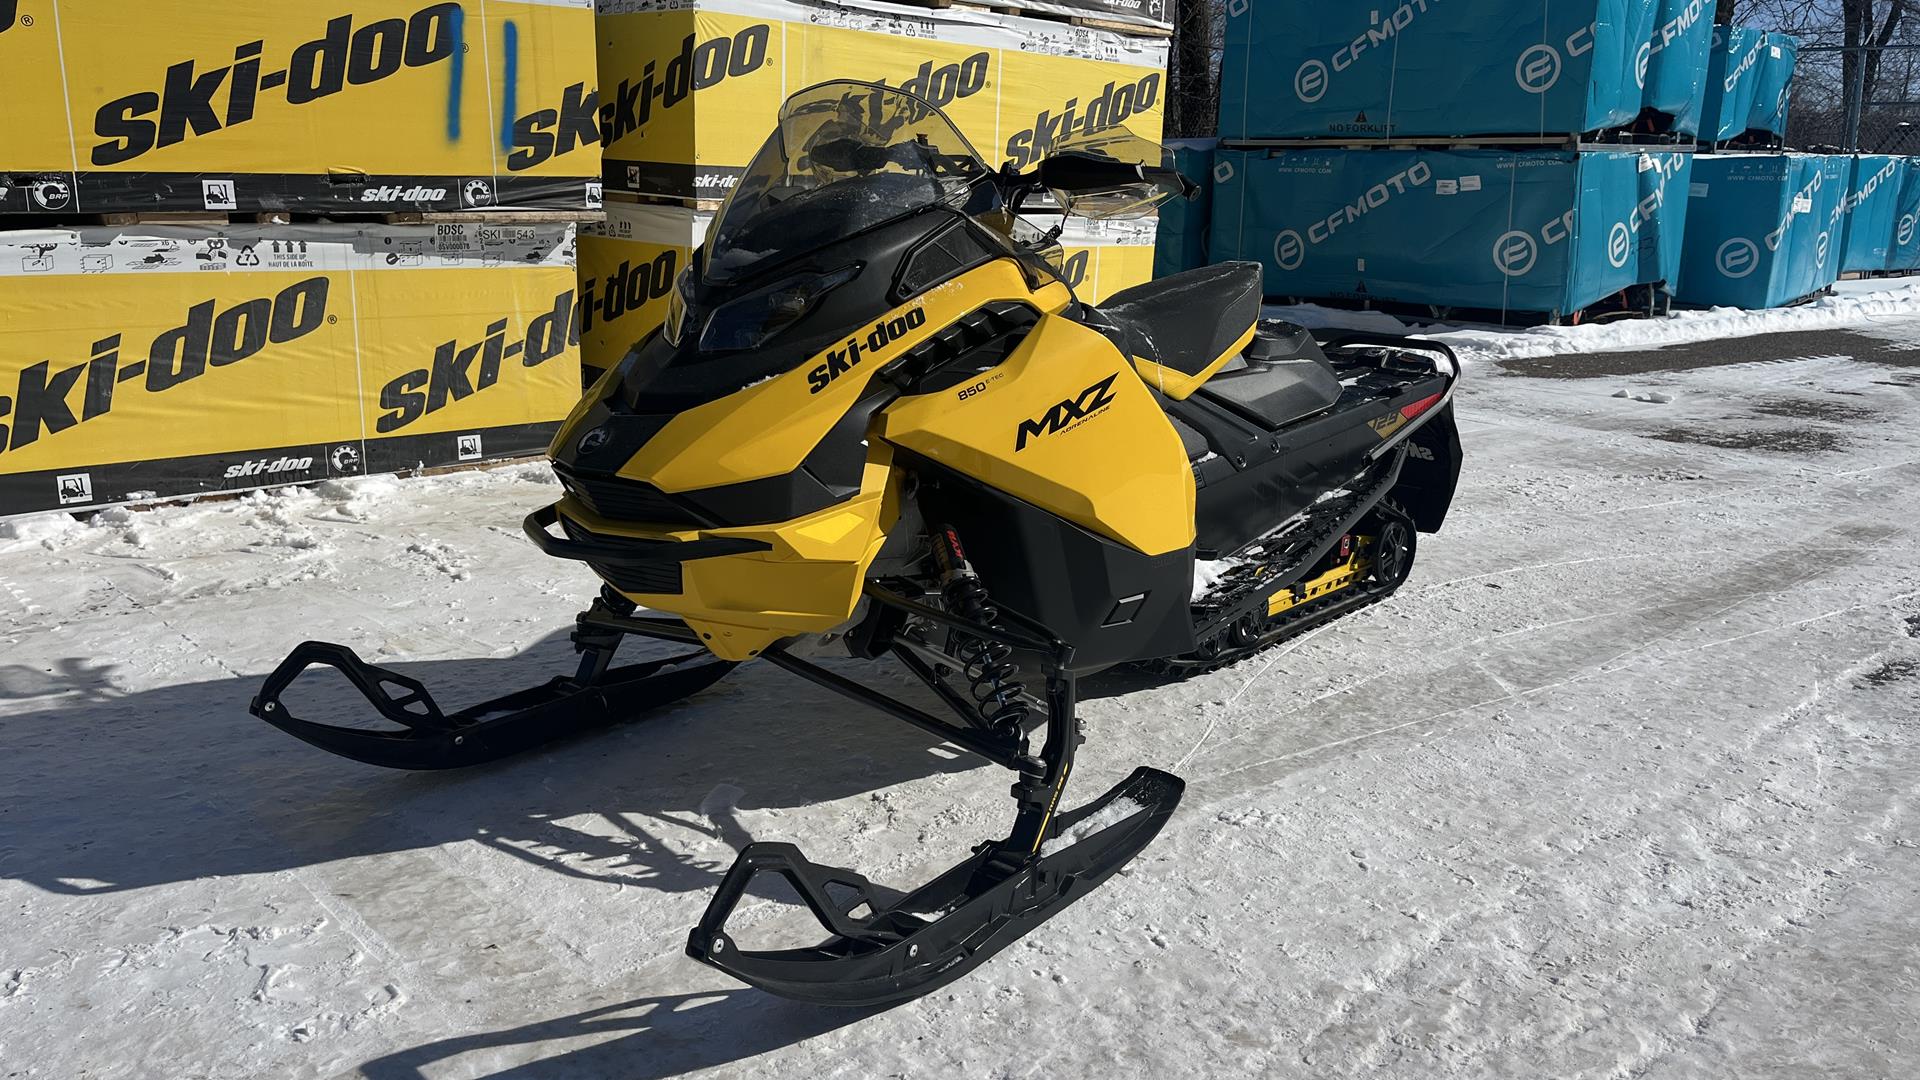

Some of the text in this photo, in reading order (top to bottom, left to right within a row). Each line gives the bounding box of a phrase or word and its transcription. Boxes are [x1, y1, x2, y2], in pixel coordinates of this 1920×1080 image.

[1331, 0, 1427, 72] CFMOT
[91, 2, 461, 166] ski-doo
[600, 24, 770, 150] ski-doo
[1006, 73, 1160, 170] ski-doo
[361, 186, 446, 202] ski-doo
[437, 224, 464, 235] BDSC
[1307, 161, 1431, 244] CFMOTO
[517, 229, 535, 239] 543
[0, 277, 330, 452] ki-doo
[808, 307, 926, 394] ski-doo
[957, 381, 987, 401] 850
[1015, 371, 1120, 453] MXZ
[1059, 405, 1111, 436] ADRENALINE
[223, 455, 313, 479] ski-doo
